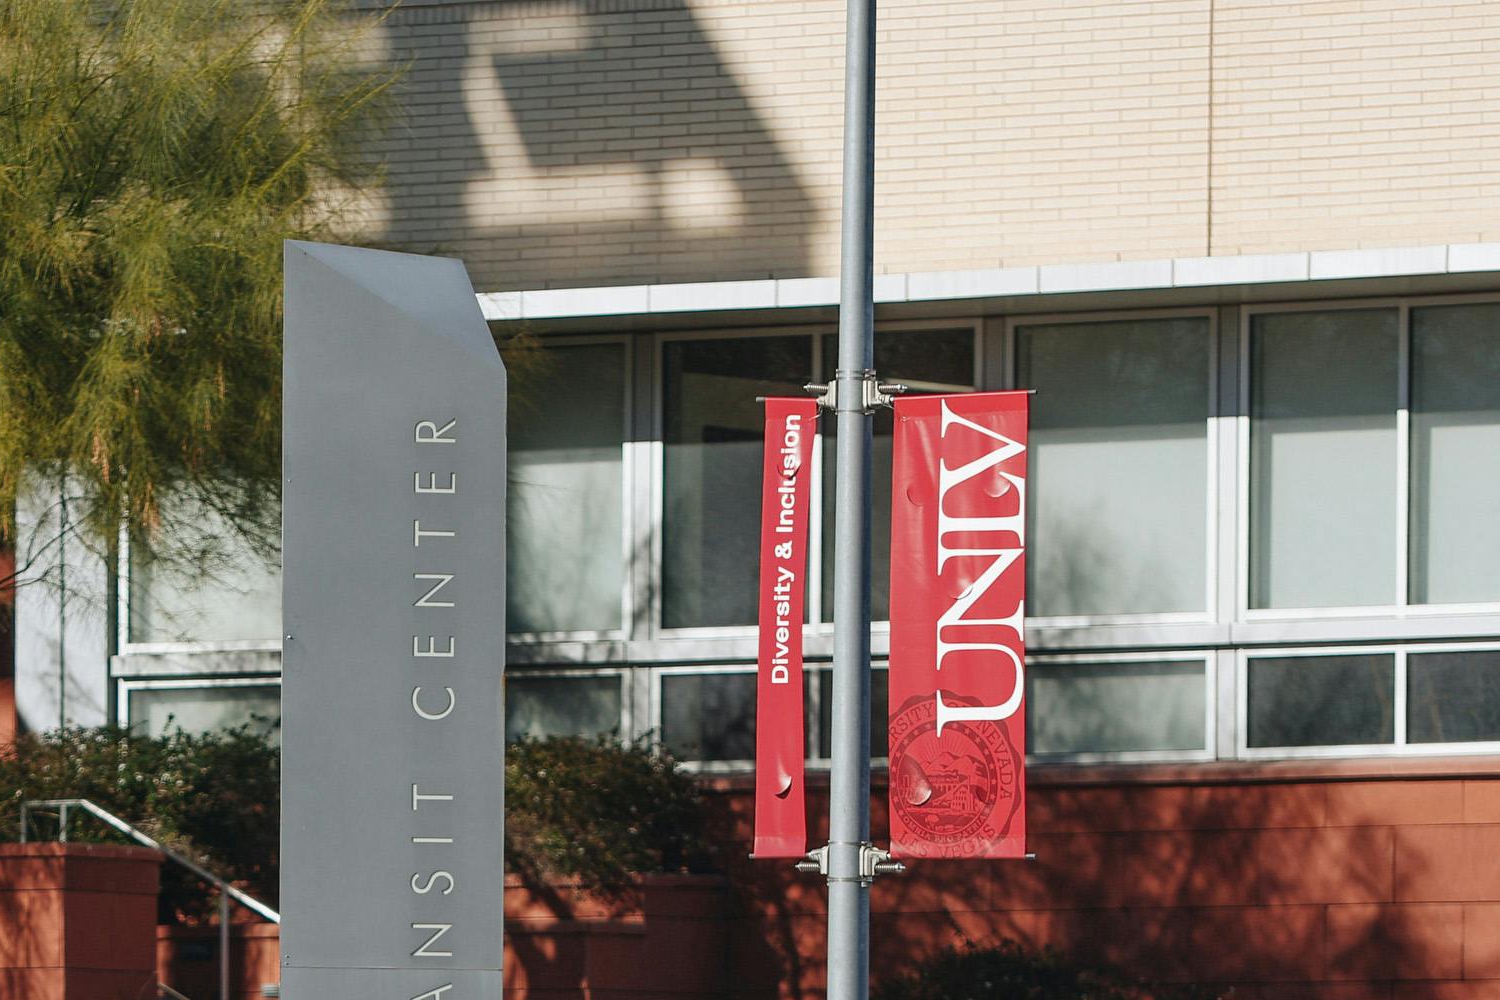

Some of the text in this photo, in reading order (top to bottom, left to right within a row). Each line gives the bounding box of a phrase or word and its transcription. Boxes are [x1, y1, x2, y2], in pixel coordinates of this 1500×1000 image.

[411, 417, 456, 720] CENTER
[771, 414, 801, 684] Diversity & Inclusion
[936, 397, 1027, 738] UNLV
[890, 701, 934, 743] RSITY
